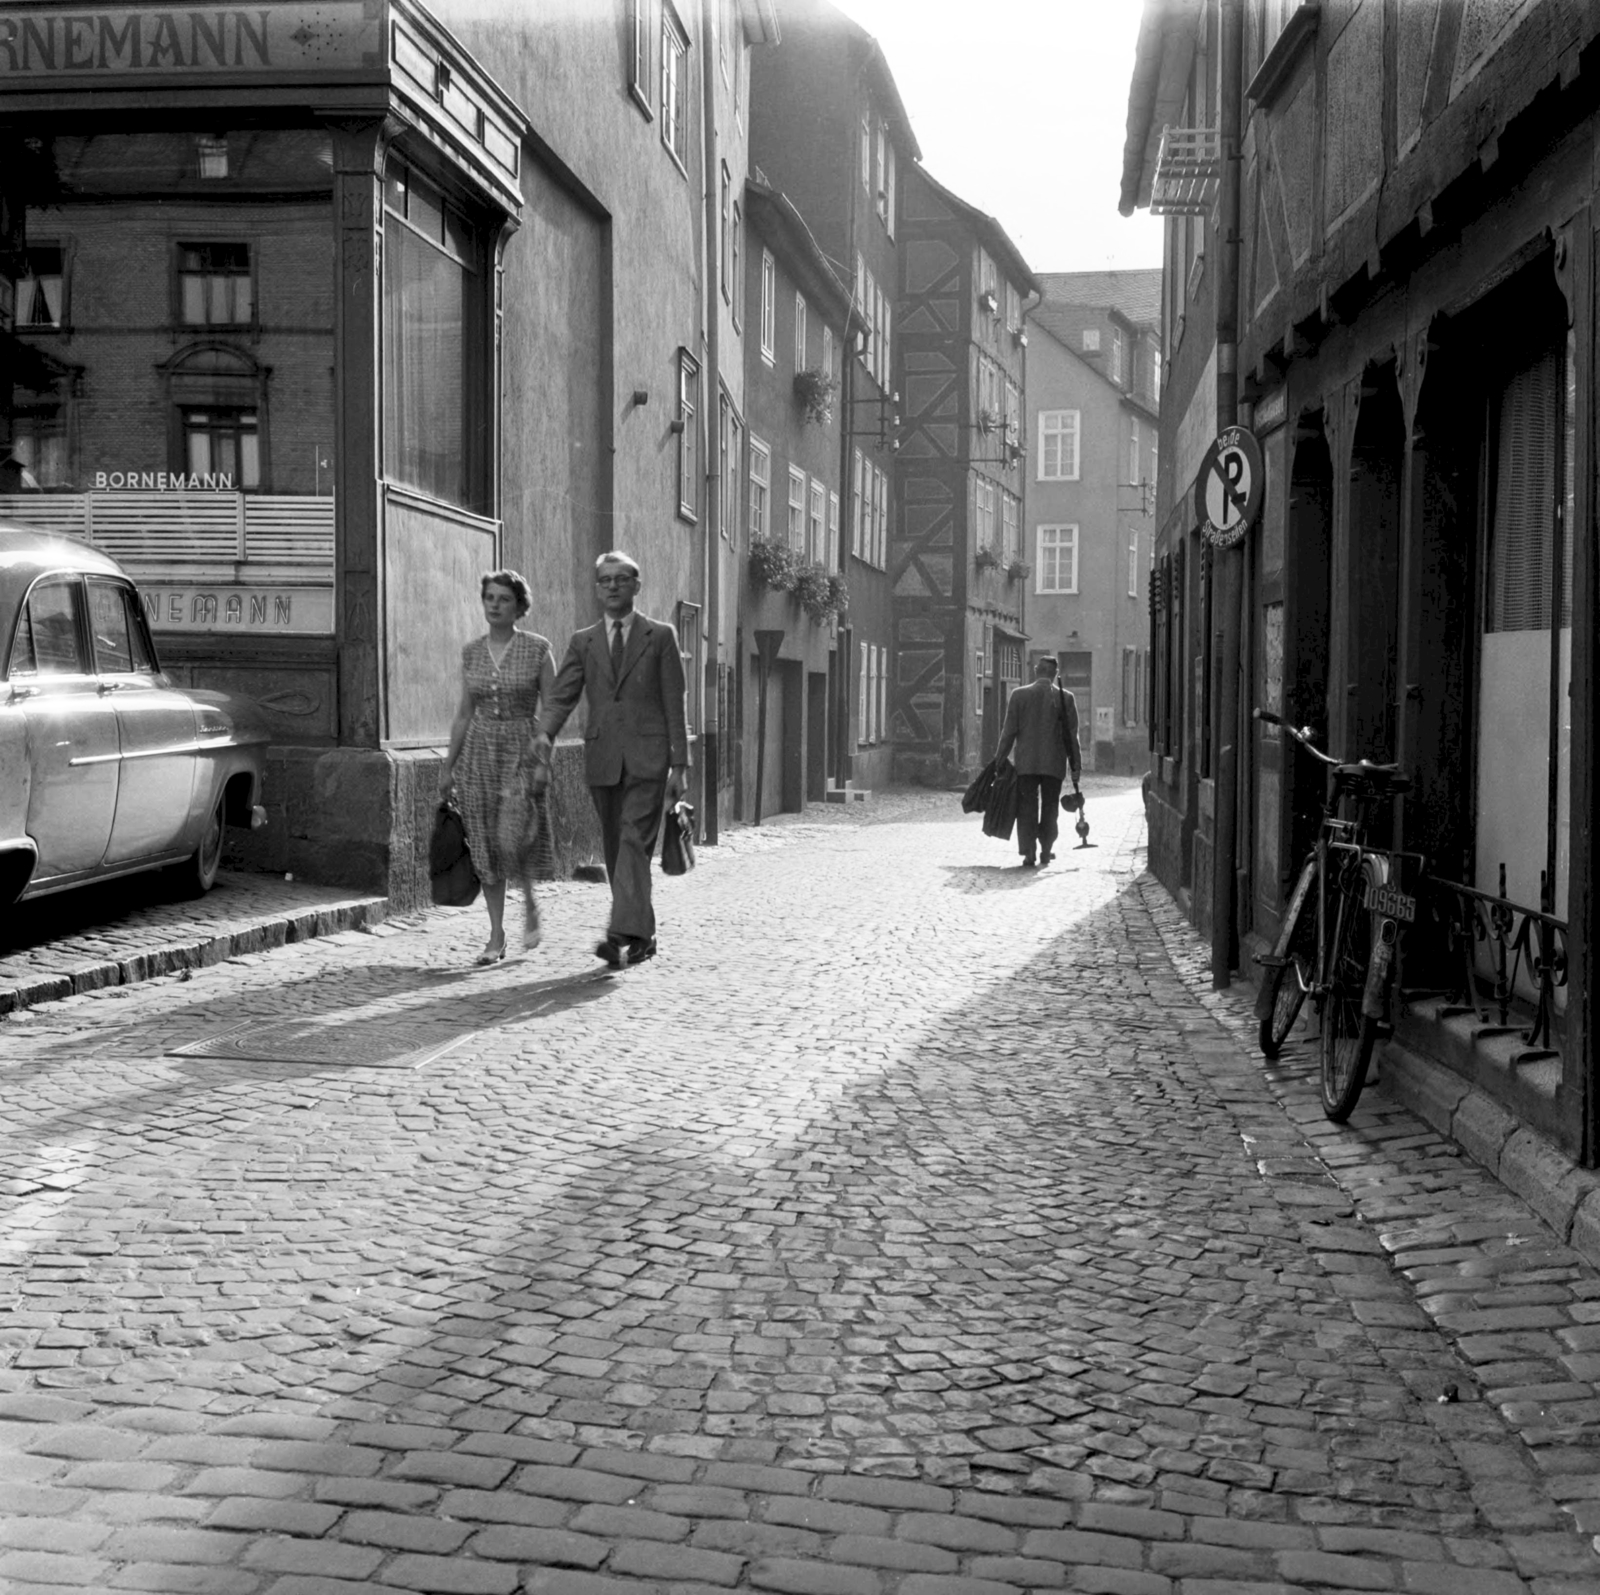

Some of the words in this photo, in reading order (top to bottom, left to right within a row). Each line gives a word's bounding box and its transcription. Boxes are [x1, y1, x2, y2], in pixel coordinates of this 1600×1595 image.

[1217, 429, 1240, 450] beide
[96, 471, 232, 489] BORNEMANN
[1202, 519, 1248, 546] Straßenseiten
